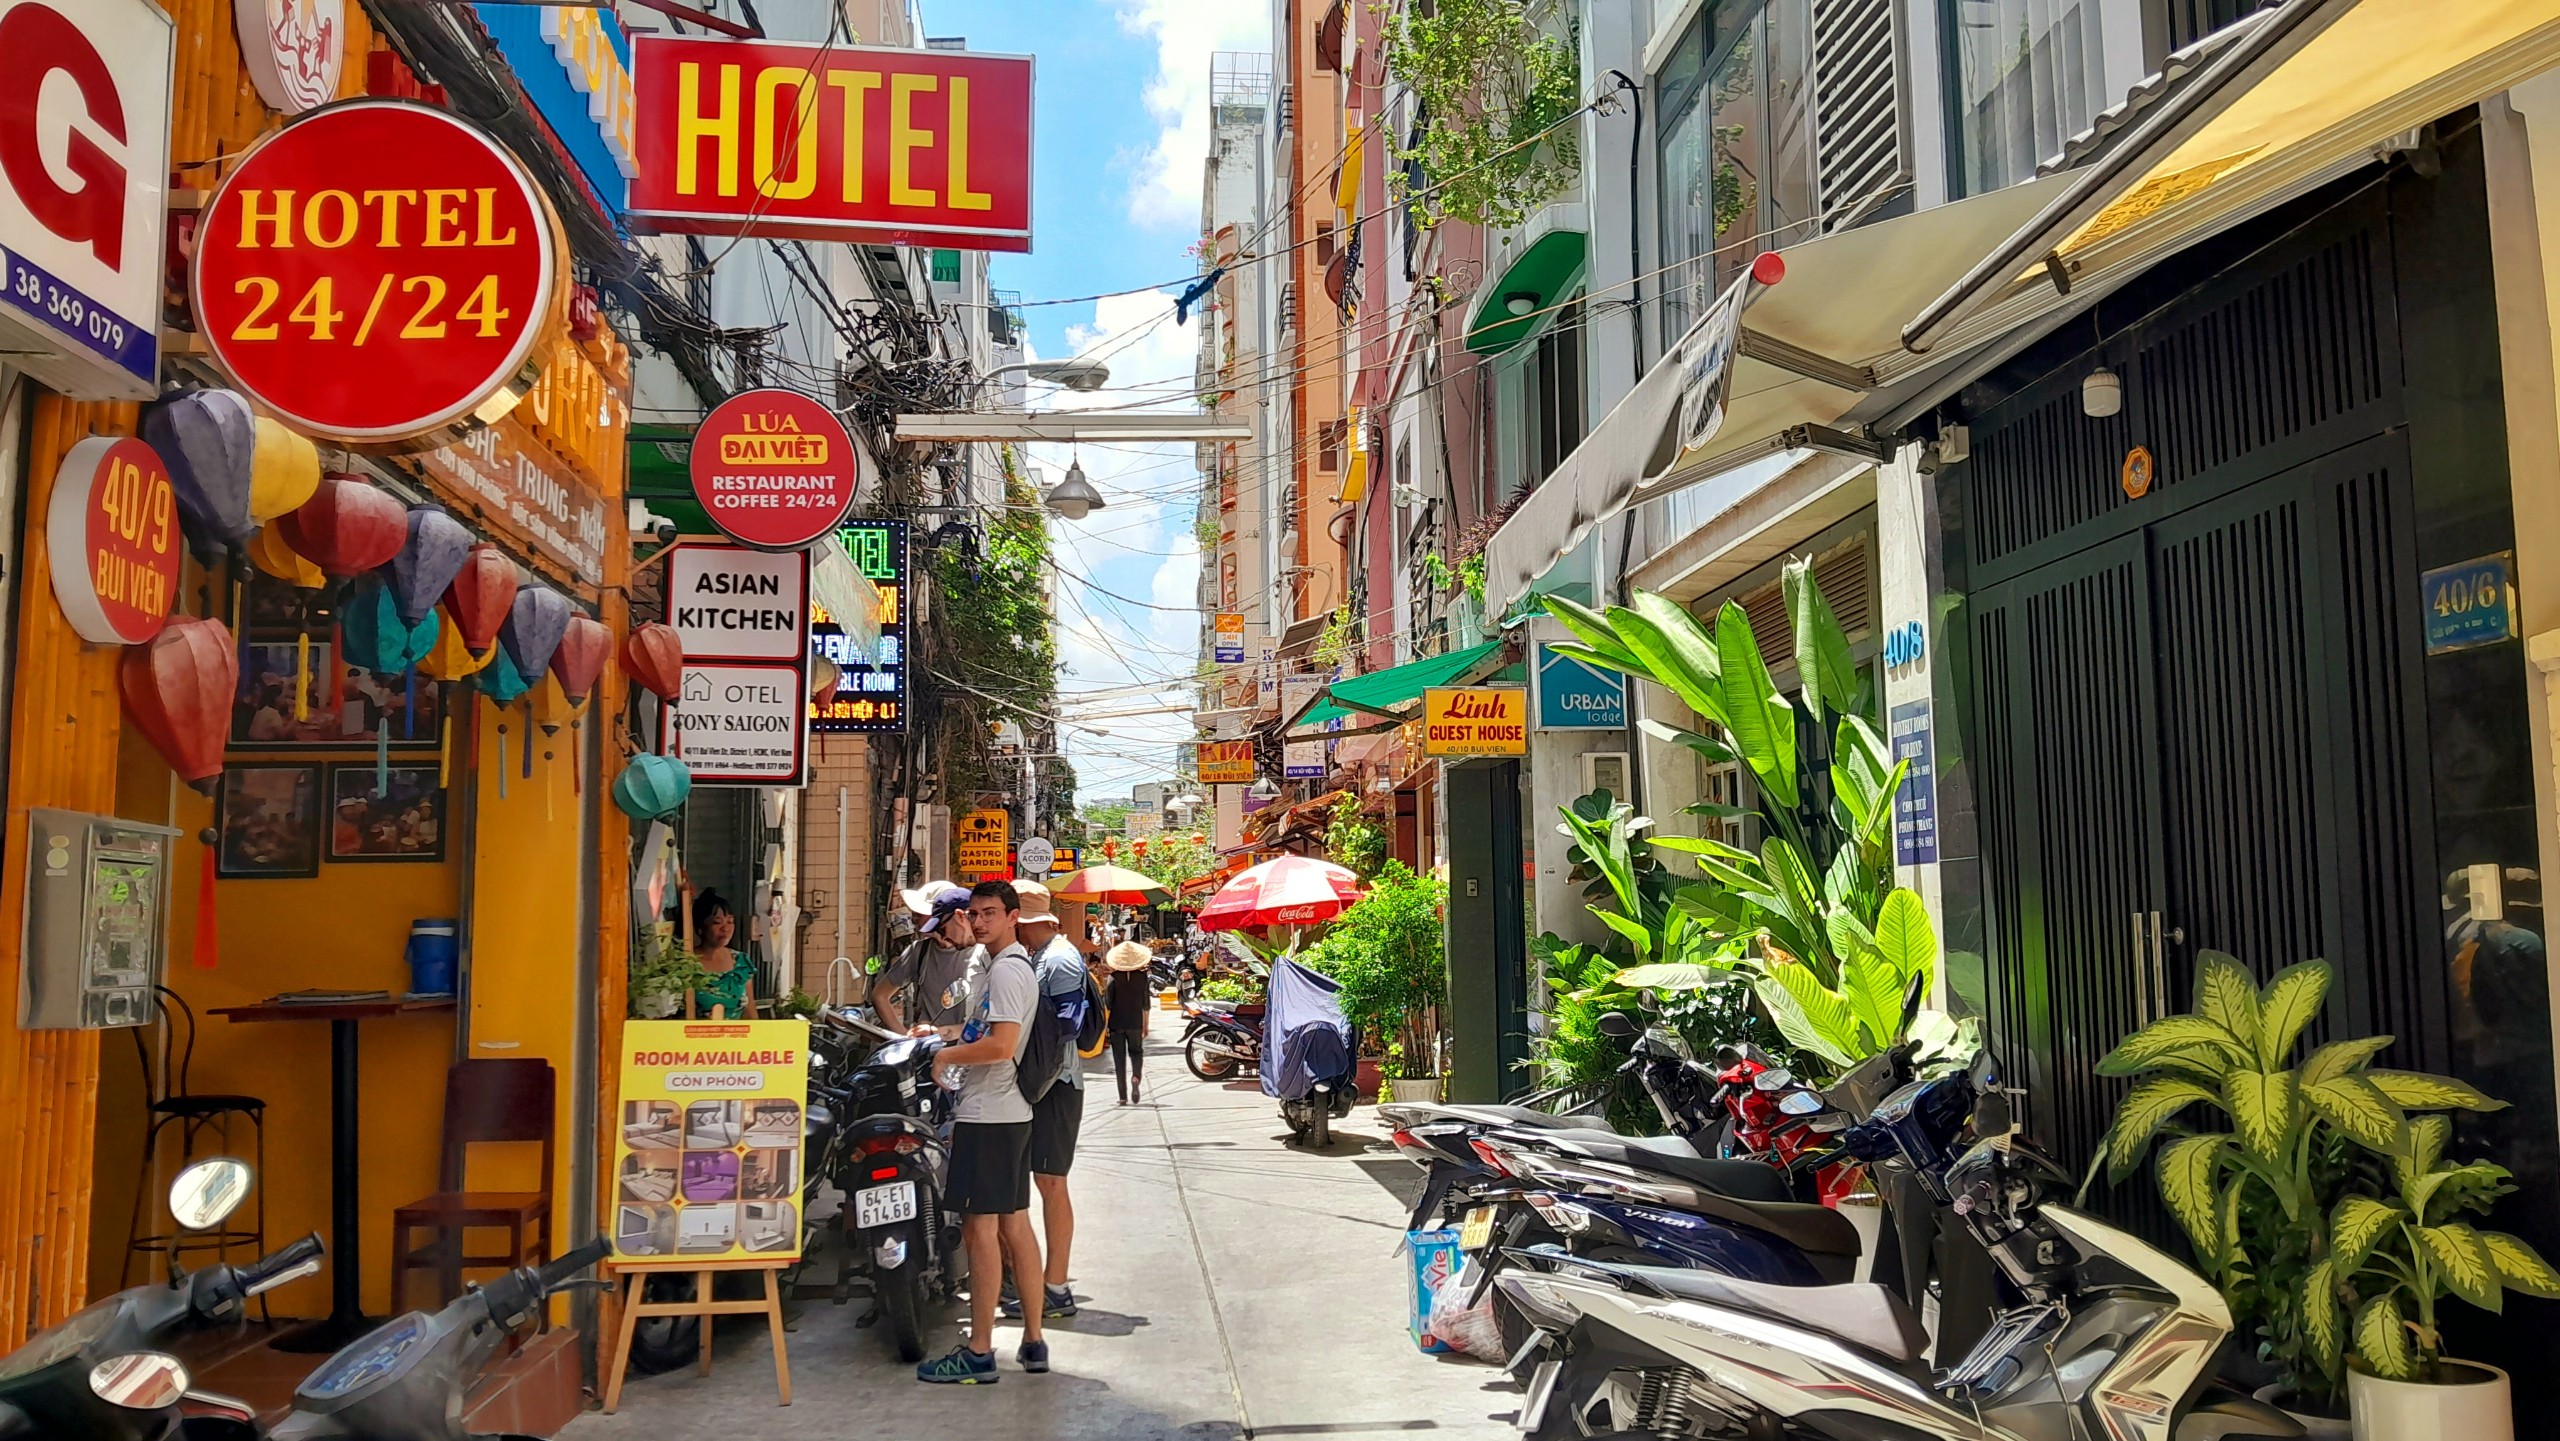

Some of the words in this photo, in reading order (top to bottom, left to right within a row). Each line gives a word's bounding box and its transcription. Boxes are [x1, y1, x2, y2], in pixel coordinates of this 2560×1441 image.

[676, 62, 992, 211] HOTEL
[236, 188, 516, 248] HOTEL
[15, 266, 42, 304] 38
[47, 286, 84, 327] 369
[89, 311, 124, 350] 079
[231, 274, 509, 346] 24/24
[741, 409, 802, 433] LÚA
[725, 440, 766, 463] ĐẠI
[770, 435, 824, 463] VIỆT
[712, 475, 837, 491] RESTAURANT
[102, 456, 171, 555] 40/9
[515, 450, 569, 523] TRUNG
[579, 506, 606, 557] NAM
[713, 494, 780, 509] COFFEE
[784, 493, 837, 509] 24/24
[97, 543, 126, 603] BÙI
[130, 560, 165, 624] VIỆN
[695, 572, 779, 596] ASIAN
[2433, 571, 2497, 618] 40/6
[678, 607, 794, 631] KITCHEN
[1884, 619, 1923, 669] 40/8
[863, 672, 896, 691] ROOM
[1442, 692, 1509, 720] Linh
[1561, 693, 1620, 711] URBAN
[674, 713, 721, 731] TONY
[724, 714, 791, 733] SAIGON
[1429, 725, 1473, 742] GUEST
[1478, 725, 1523, 742] HOUSE
[1200, 742, 1252, 762] KIM
[1446, 745, 1469, 753] 40/10
[1471, 745, 1485, 753] BUI
[1486, 745, 1507, 753] VIEN
[1207, 761, 1244, 771] HOTEL
[962, 832, 1002, 843] TIME
[633, 1051, 690, 1066] ROOM
[693, 1050, 794, 1066] AVAILABLE
[672, 1075, 702, 1088] CÒN
[706, 1074, 757, 1087] PHÒNG
[865, 1185, 905, 1207] 64-E1
[862, 1201, 911, 1225] 614.68
[1622, 1207, 1697, 1229] VISION
[1430, 1250, 1447, 1291] Vie
